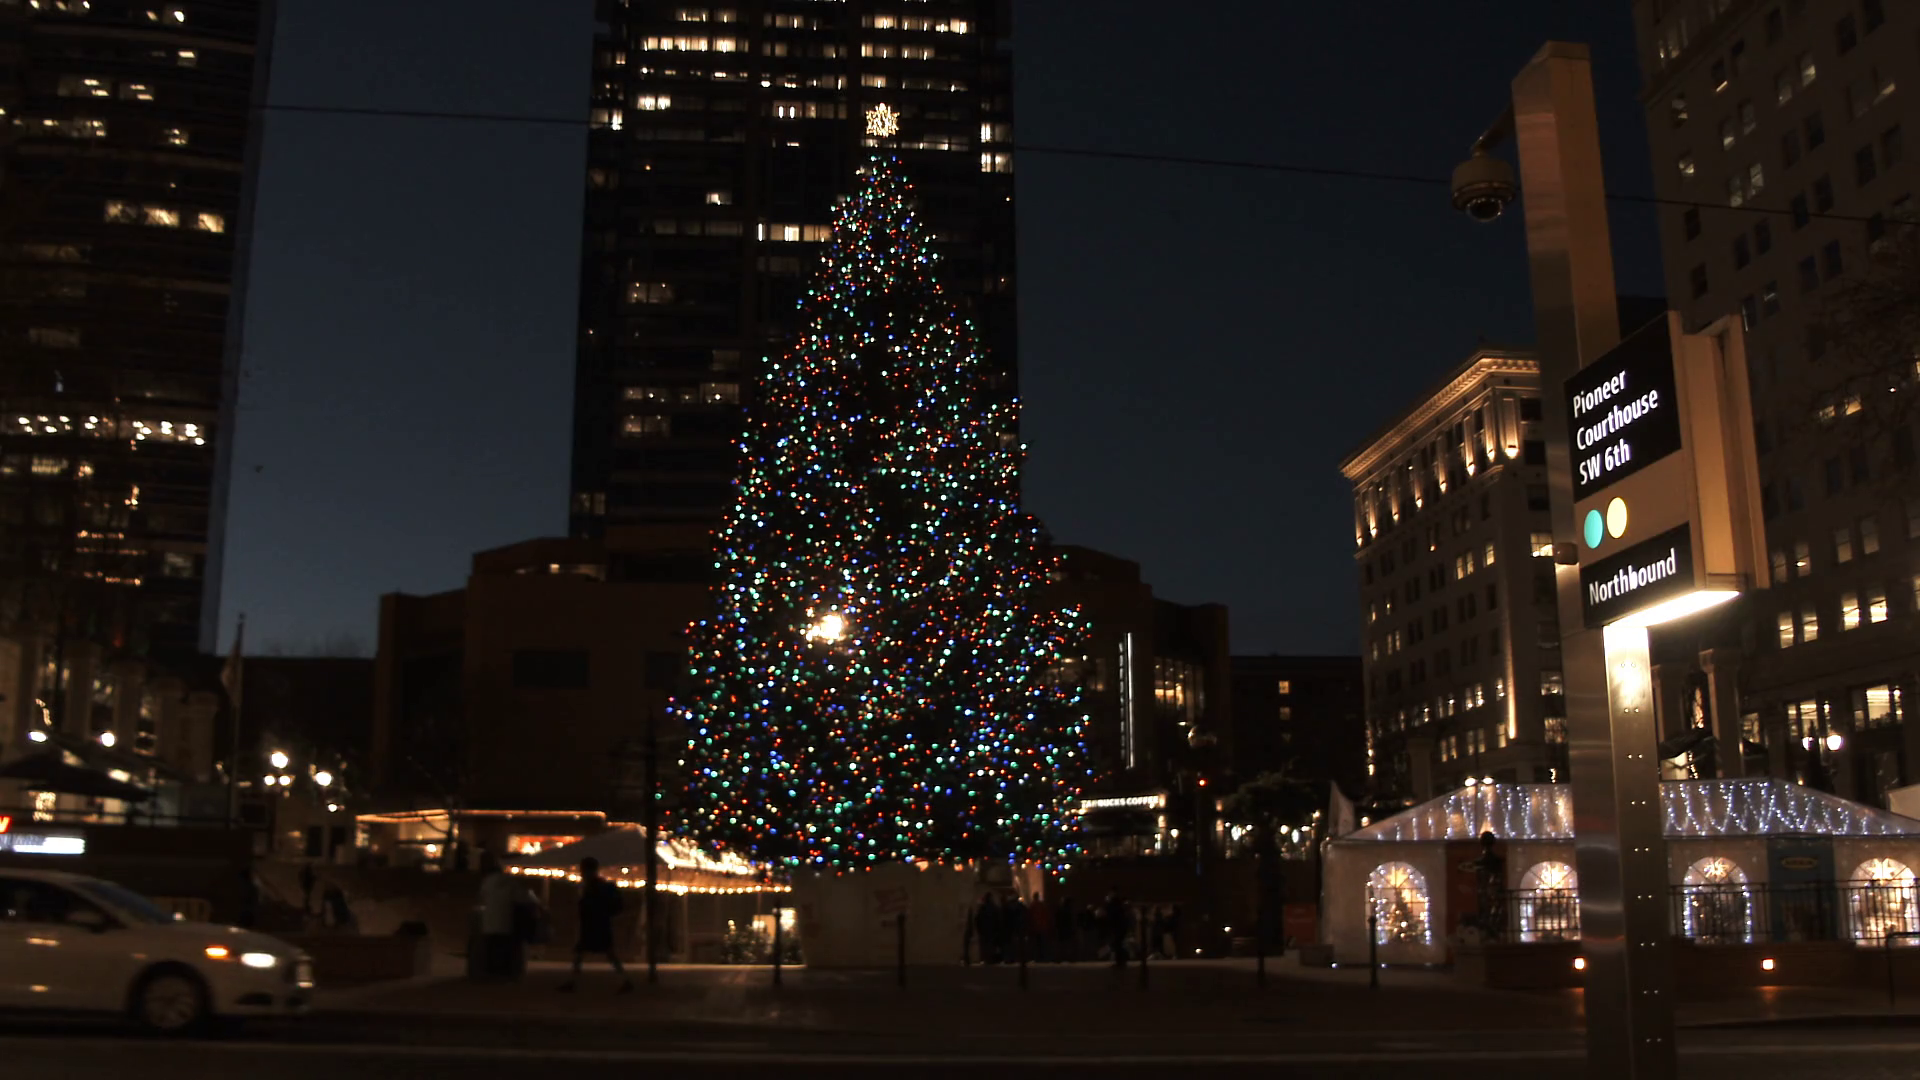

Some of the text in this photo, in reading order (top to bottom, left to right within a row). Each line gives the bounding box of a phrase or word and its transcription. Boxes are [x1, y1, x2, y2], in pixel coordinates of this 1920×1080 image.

[1573, 370, 1626, 418] Pioneer
[1576, 389, 1658, 450] Courthouse
[1579, 438, 1631, 485] SW 6th
[1589, 547, 1676, 606] Northbound
[1079, 798, 1126, 808] TARBUCKS
